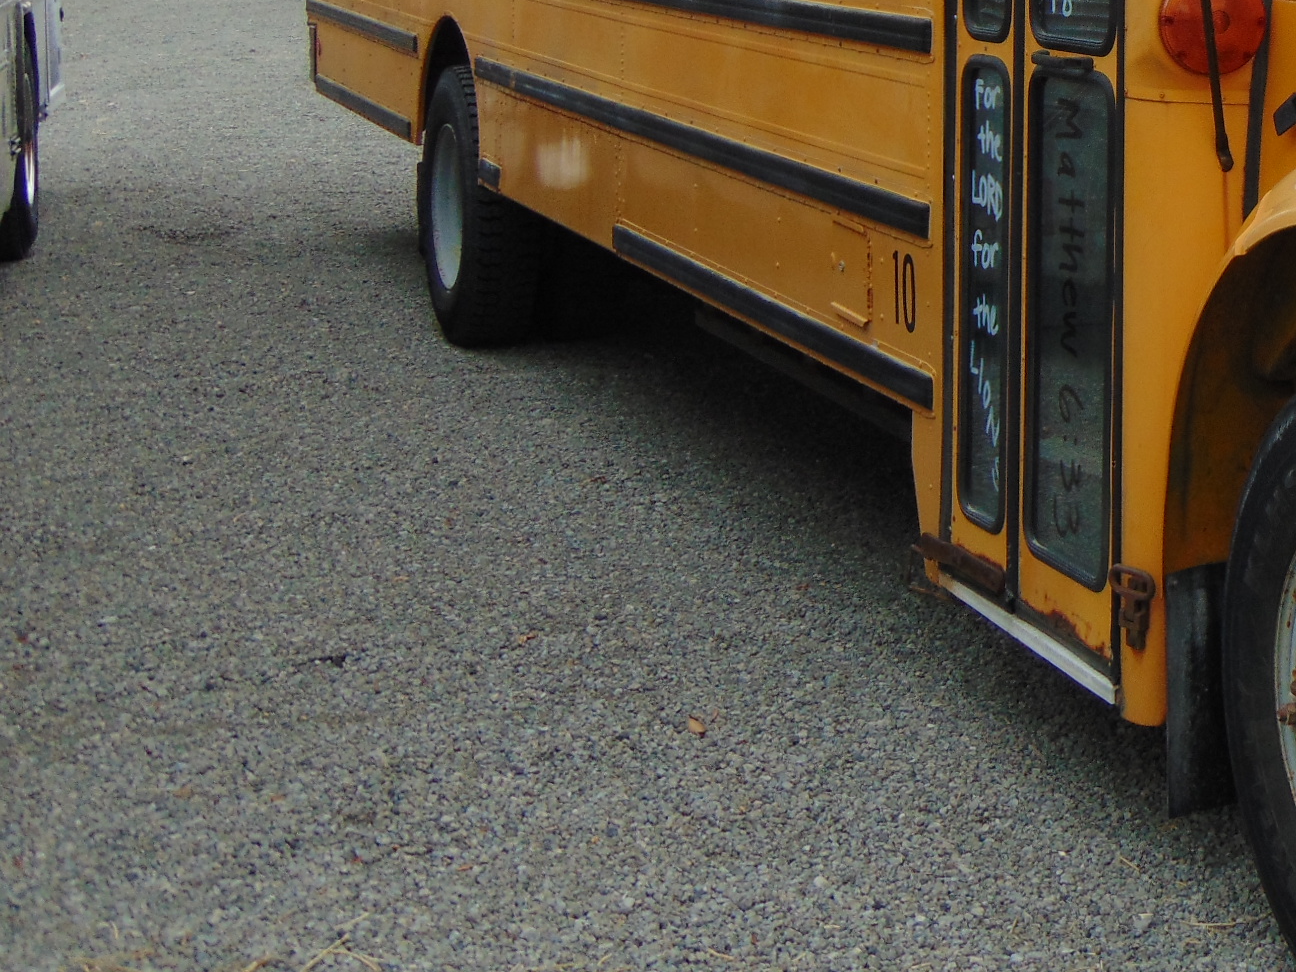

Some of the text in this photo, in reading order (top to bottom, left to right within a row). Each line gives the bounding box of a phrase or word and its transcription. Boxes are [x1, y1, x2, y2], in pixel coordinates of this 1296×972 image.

[976, 120, 1003, 162] the
[971, 170, 1003, 222] LORD
[971, 229, 999, 269] for
[892, 250, 916, 333] 10
[972, 293, 999, 336] the
